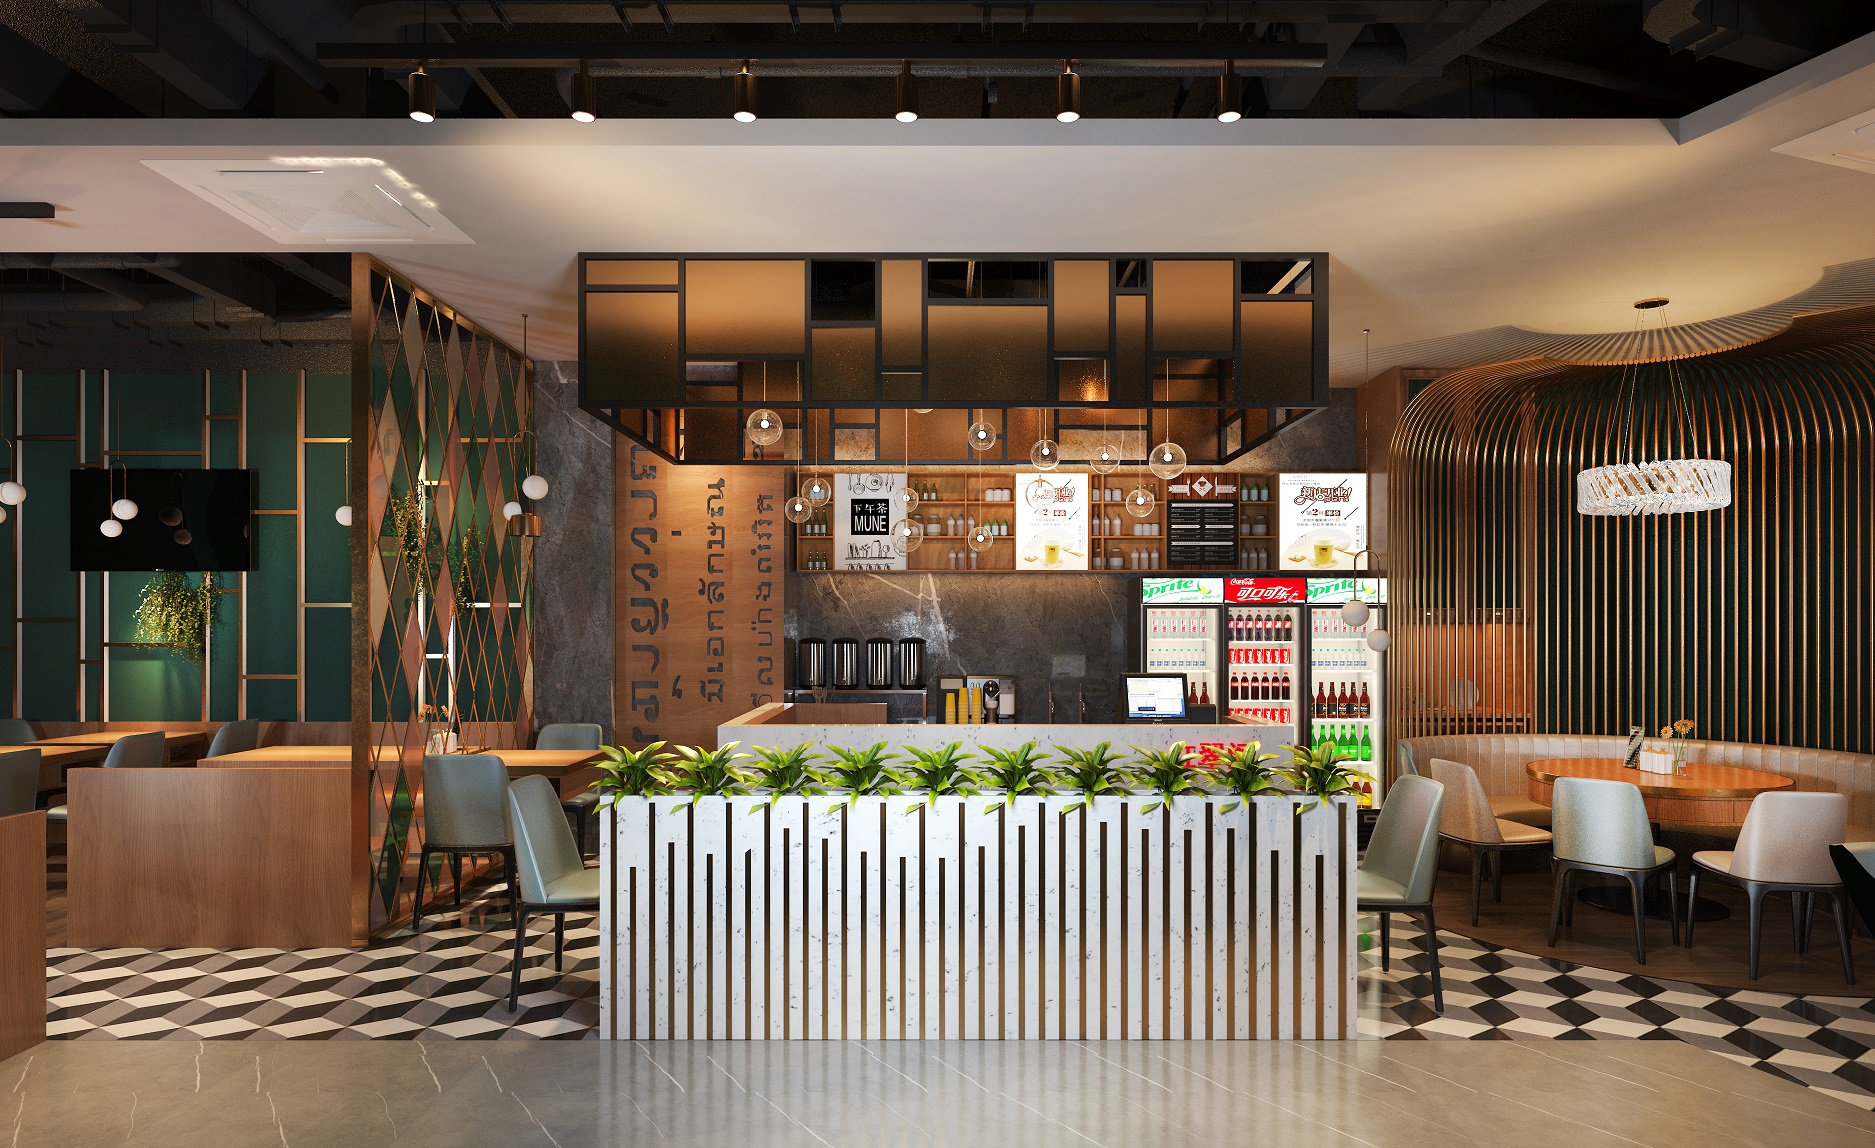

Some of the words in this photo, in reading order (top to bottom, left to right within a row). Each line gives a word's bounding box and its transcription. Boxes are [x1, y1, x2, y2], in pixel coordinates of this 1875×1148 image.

[852, 502, 888, 514] 下午茶
[854, 515, 887, 532] MUNE
[1237, 586, 1293, 601] 可口可乐
